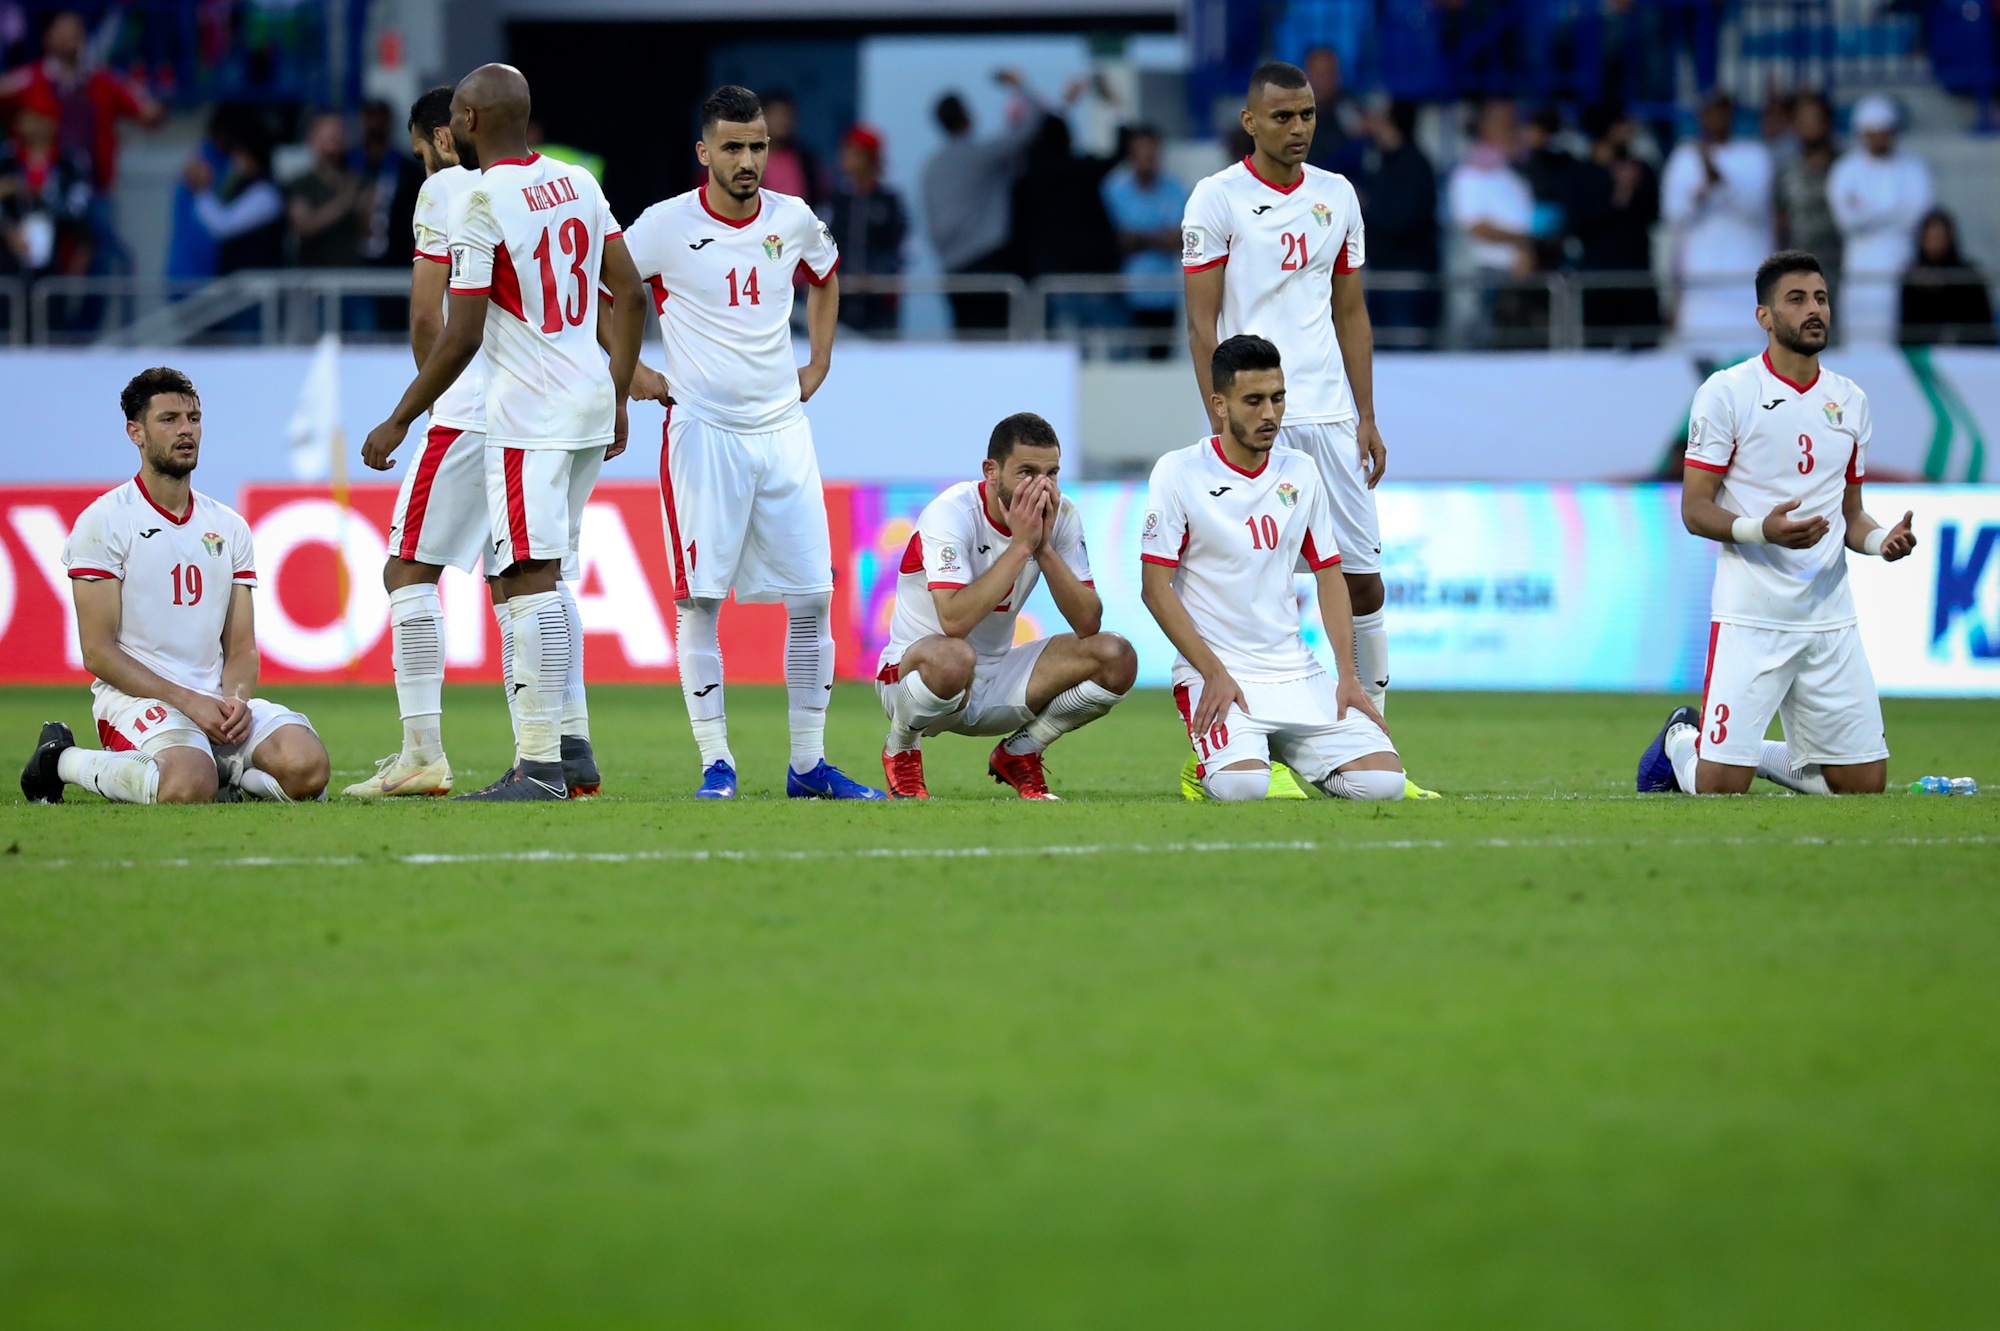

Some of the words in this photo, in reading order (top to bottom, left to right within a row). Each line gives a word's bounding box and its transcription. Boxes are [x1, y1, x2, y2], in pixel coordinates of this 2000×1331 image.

[521, 176, 579, 212] KHALIL
[1280, 232, 1309, 271] 21
[533, 217, 590, 334] 13
[725, 266, 761, 307] 14
[1798, 433, 1816, 475] 3
[1245, 514, 1279, 551] 10
[170, 563, 204, 606] 19
[131, 704, 168, 734] 19
[1709, 703, 1731, 745] 3
[1198, 721, 1229, 760] 10
